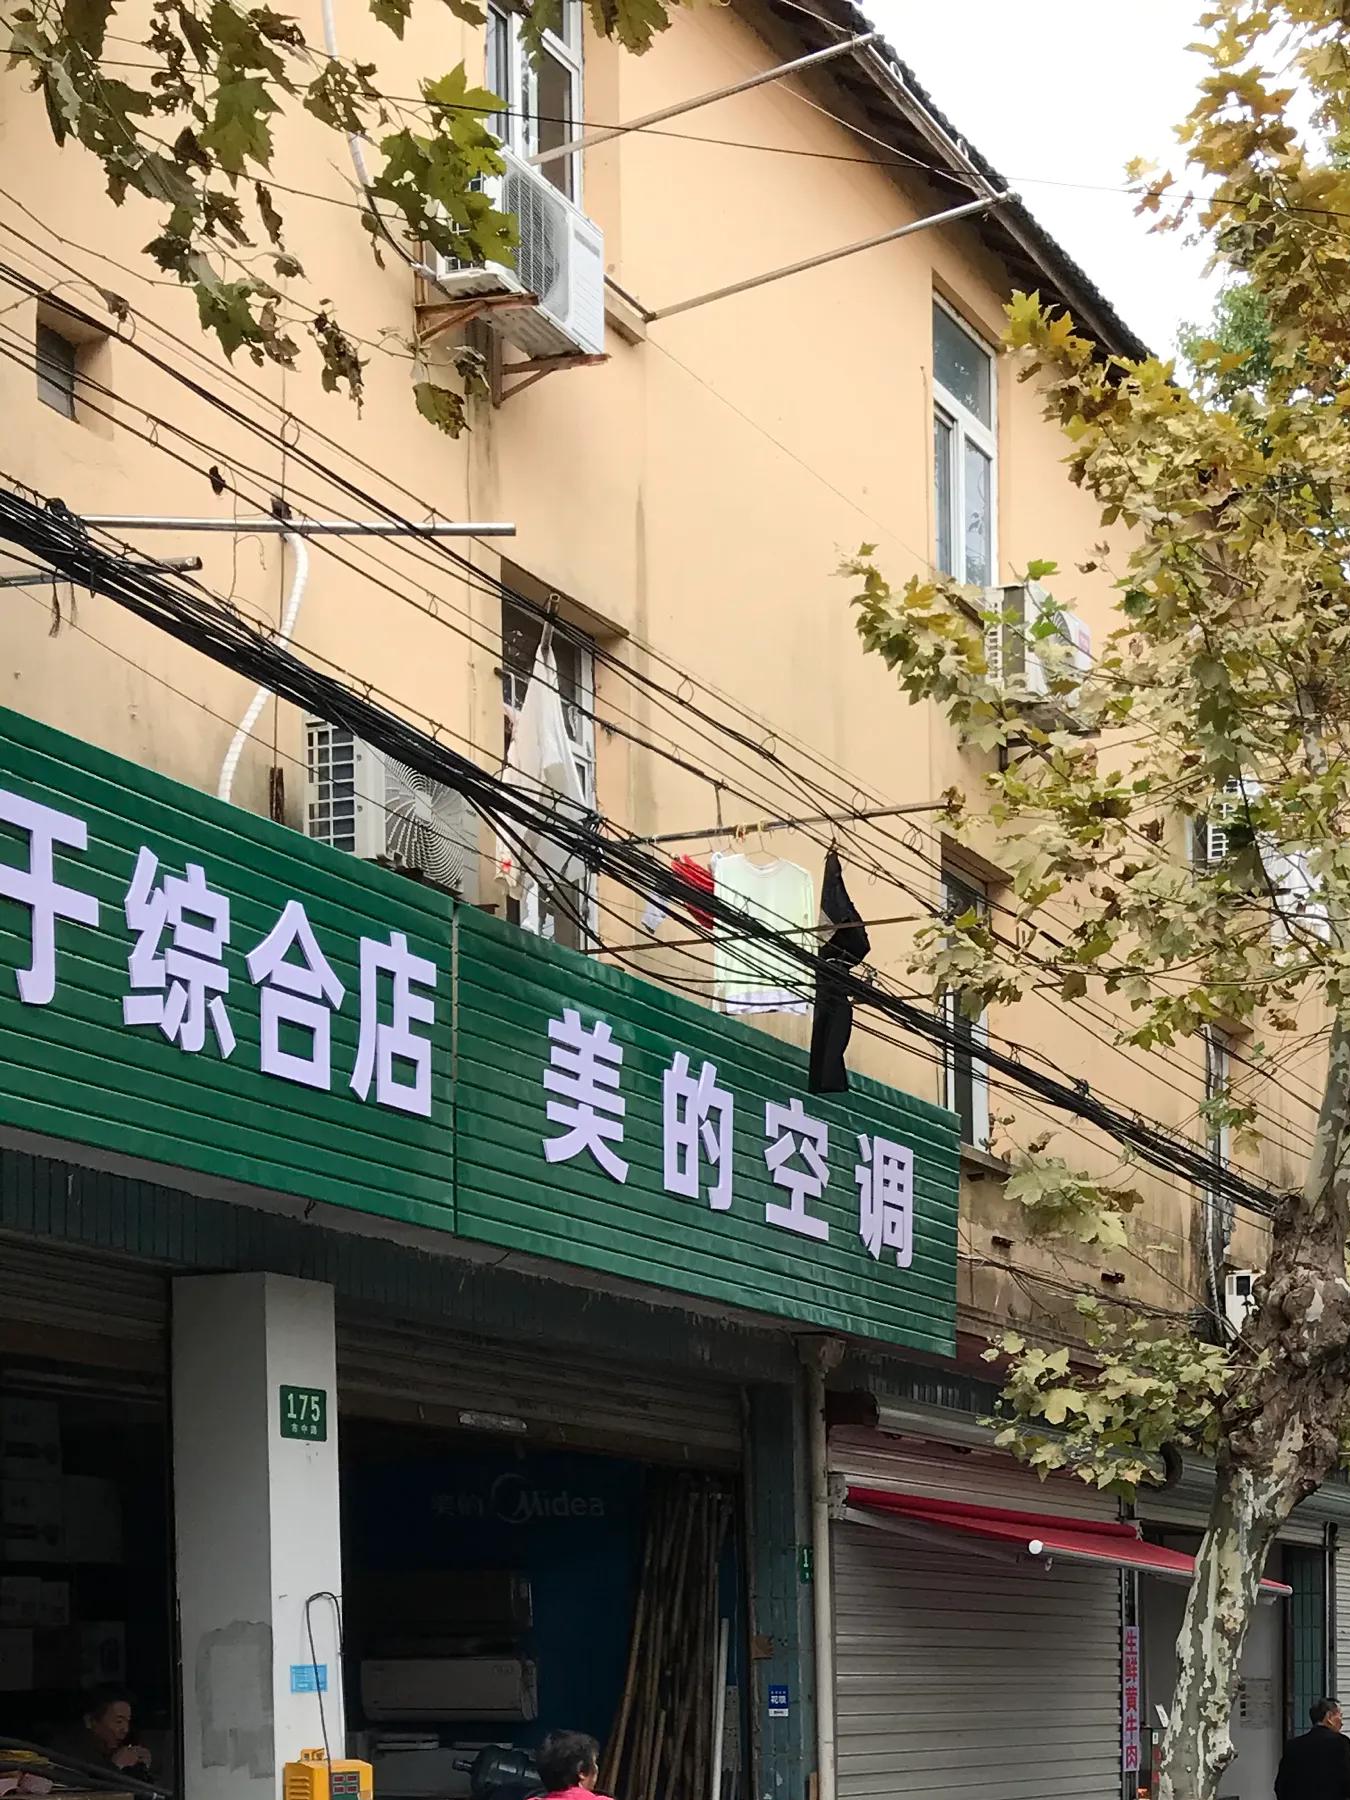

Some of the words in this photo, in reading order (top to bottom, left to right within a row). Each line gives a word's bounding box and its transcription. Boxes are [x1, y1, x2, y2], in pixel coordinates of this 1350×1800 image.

[542, 1007, 915, 1268] 美的空调
[287, 1393, 321, 1422] 175
[511, 1489, 606, 1518] Midea
[1124, 1630, 1138, 1769] 生鲜黄牛肉
